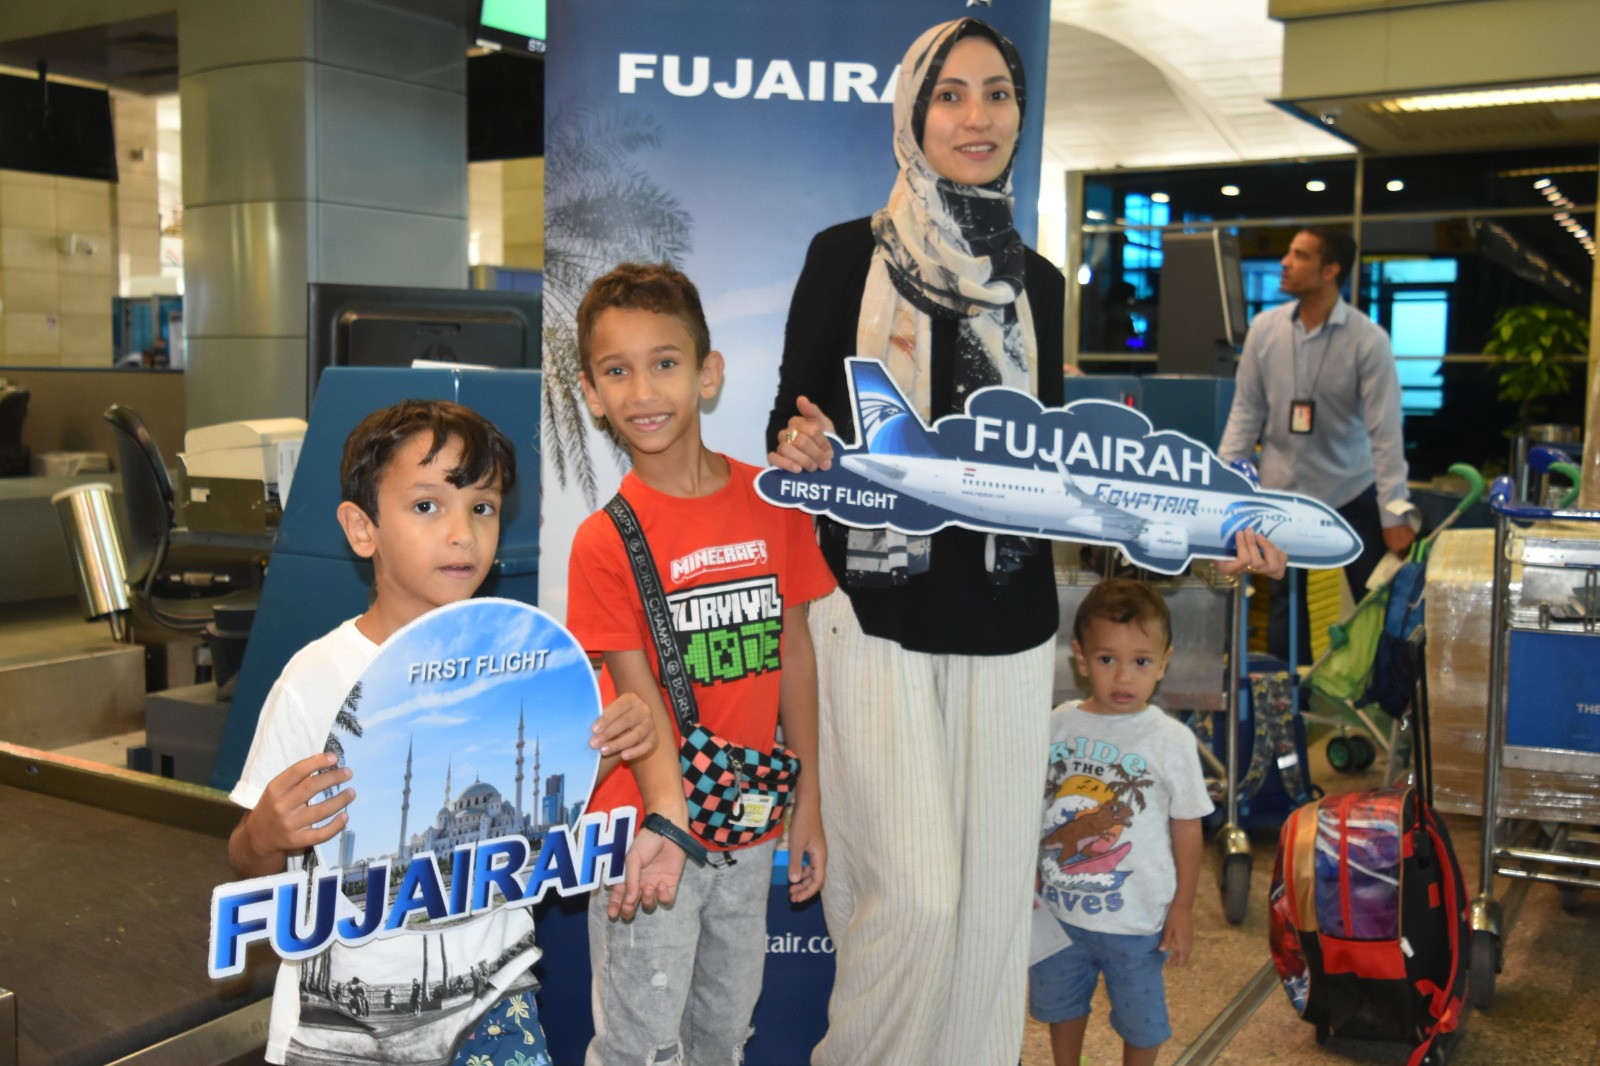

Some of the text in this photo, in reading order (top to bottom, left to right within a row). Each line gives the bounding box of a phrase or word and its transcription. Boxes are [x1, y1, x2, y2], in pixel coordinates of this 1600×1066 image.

[974, 416, 1211, 486] FUJAIRAH
[780, 479, 898, 510] FIRST FLIGHT
[671, 540, 768, 583] MINECRAFT
[635, 555, 657, 595] BORN
[649, 597, 675, 657] CHAMPS
[671, 677, 692, 719] BORN
[408, 649, 549, 683] FIRST FLIGHT
[1577, 702, 1600, 715] THE
[214, 816, 630, 971] FUJAIRAH
[1043, 885, 1125, 915] aves
